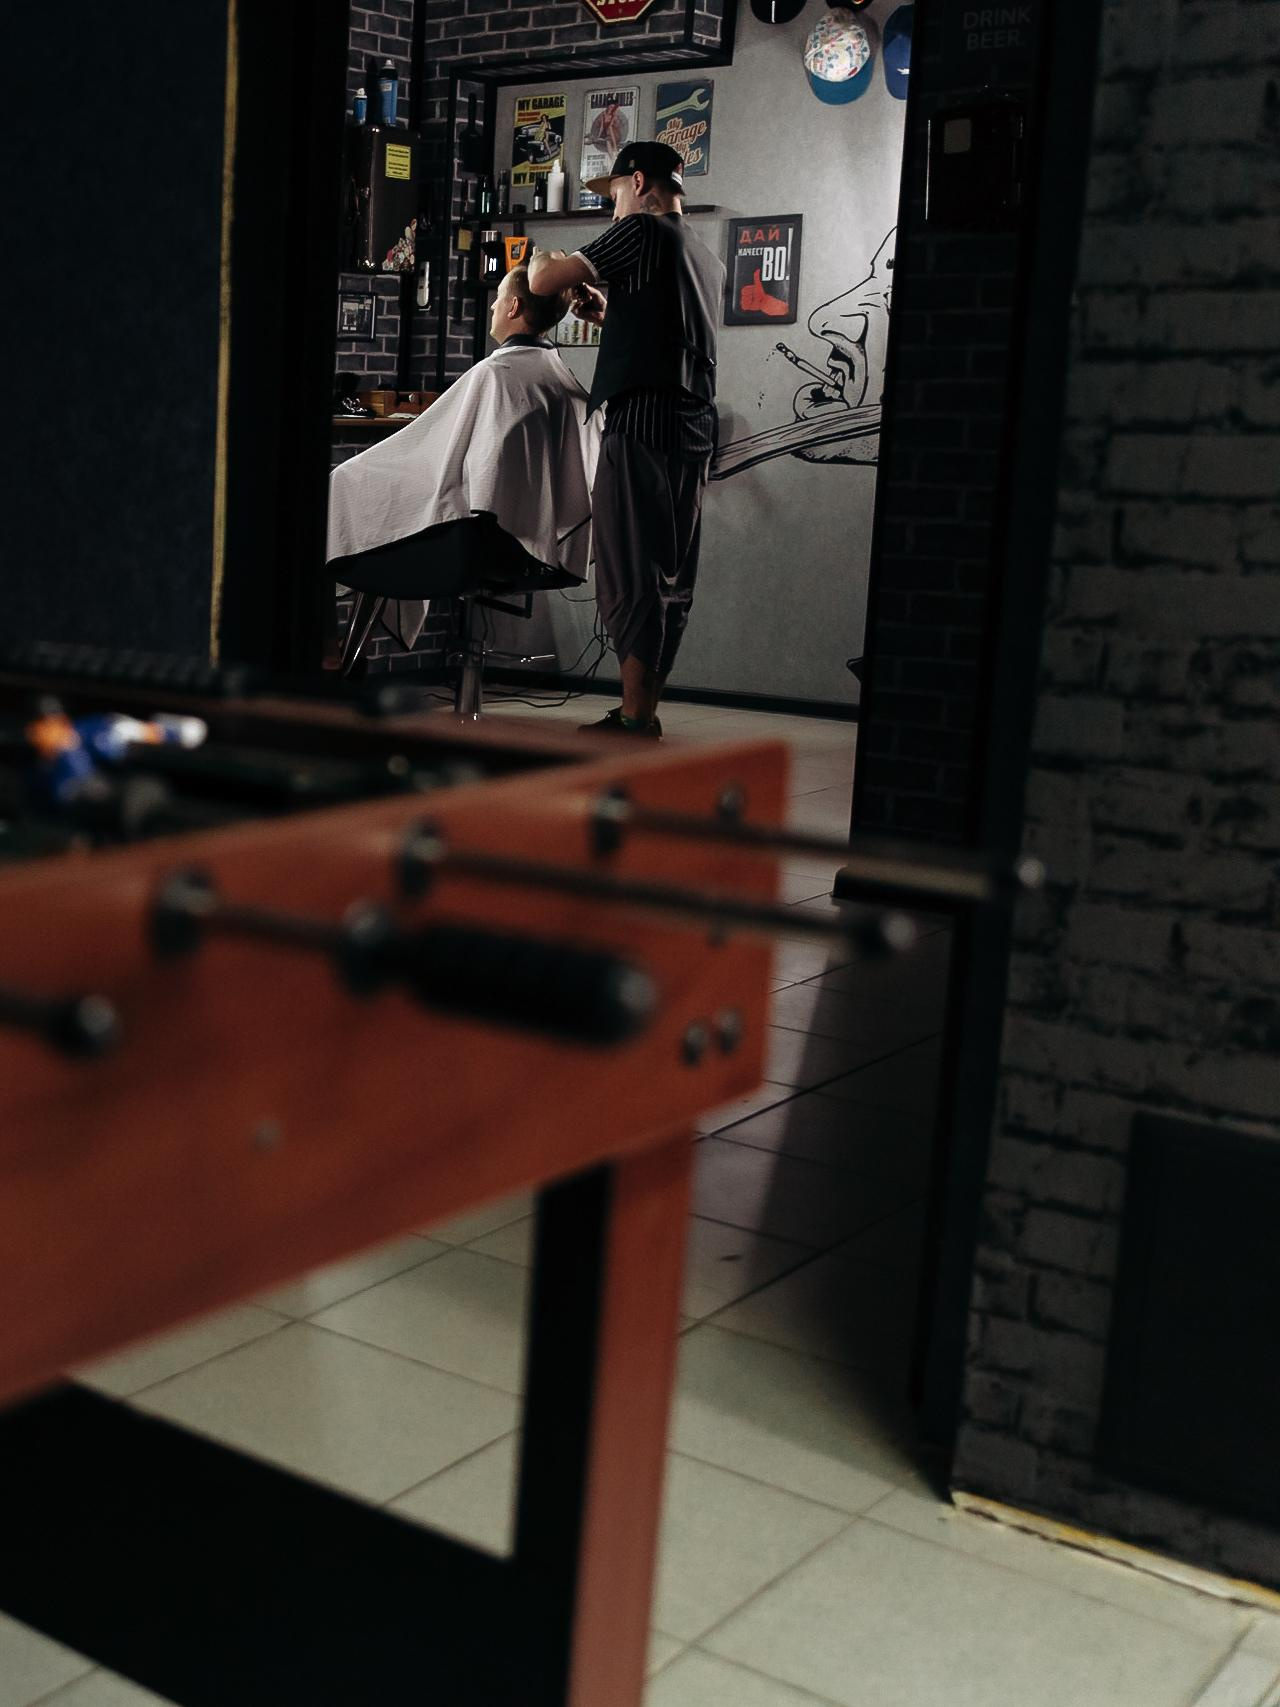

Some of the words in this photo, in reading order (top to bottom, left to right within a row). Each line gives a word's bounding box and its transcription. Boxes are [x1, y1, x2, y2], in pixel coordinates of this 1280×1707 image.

[963, 6, 1032, 30] DRINK
[518, 99, 531, 111] MY
[532, 95, 565, 110] GARAGE
[739, 224, 781, 244] ДАЙ
